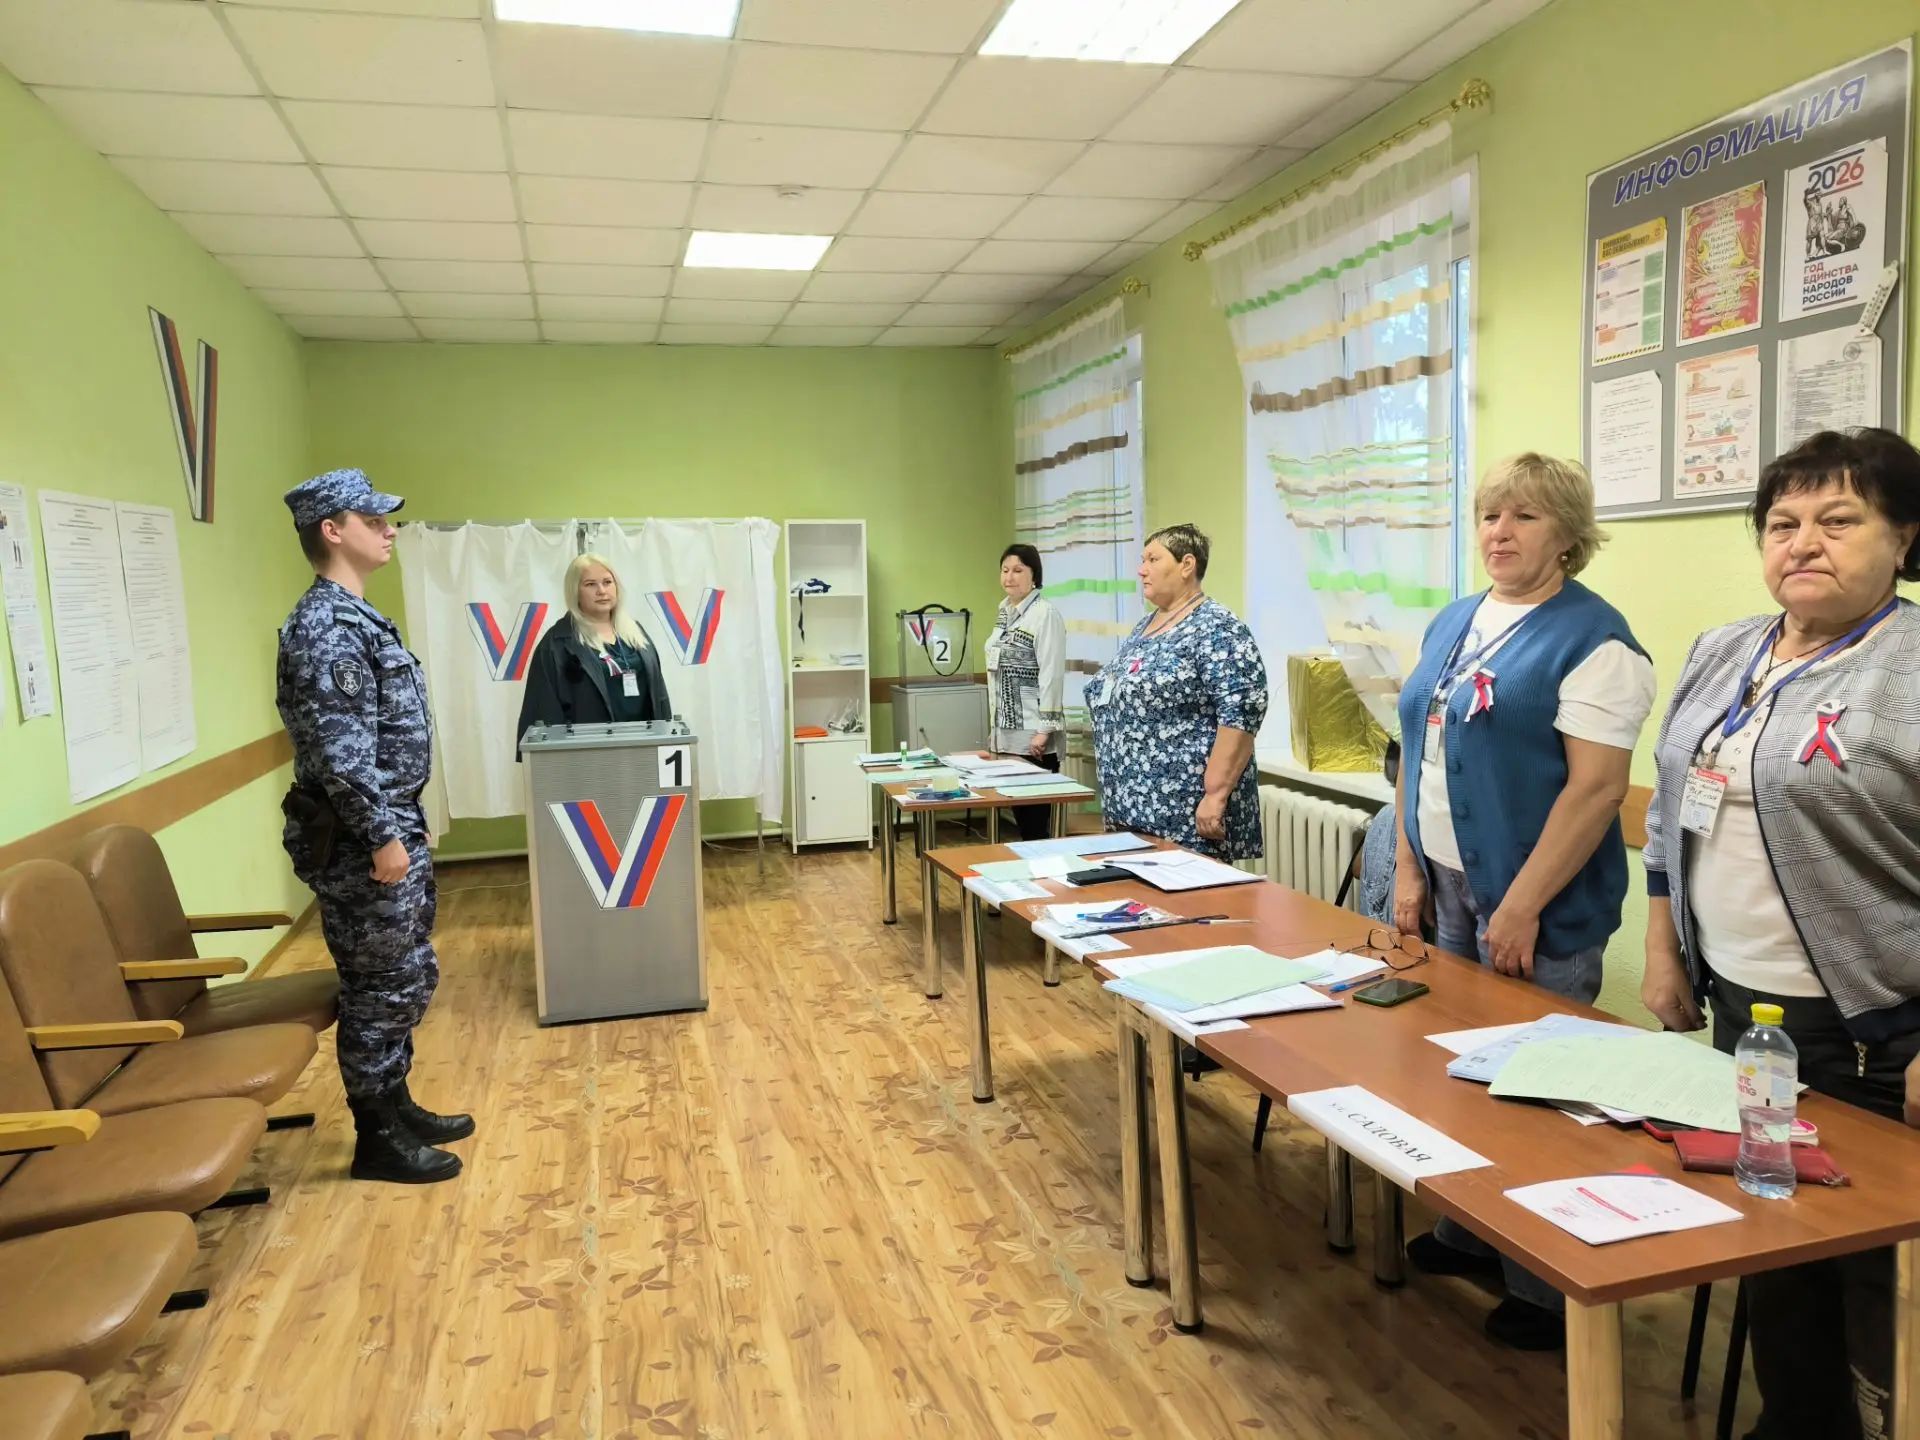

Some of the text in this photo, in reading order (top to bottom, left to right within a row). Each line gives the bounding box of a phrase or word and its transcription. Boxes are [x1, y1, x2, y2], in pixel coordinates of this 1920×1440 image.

[1613, 74, 1867, 207] ИНФОРМАЦИЯ
[1808, 157, 1864, 193] 2026
[1803, 262, 1825, 274] ГОД
[1803, 263, 1859, 285] ЕДИНСТВА
[1803, 275, 1853, 295] НАРОДОВ
[1802, 288, 1846, 305] РОССИИ
[936, 640, 948, 661] 2
[665, 750, 682, 786] 1
[1348, 1112, 1432, 1162] САДОВАЯ
